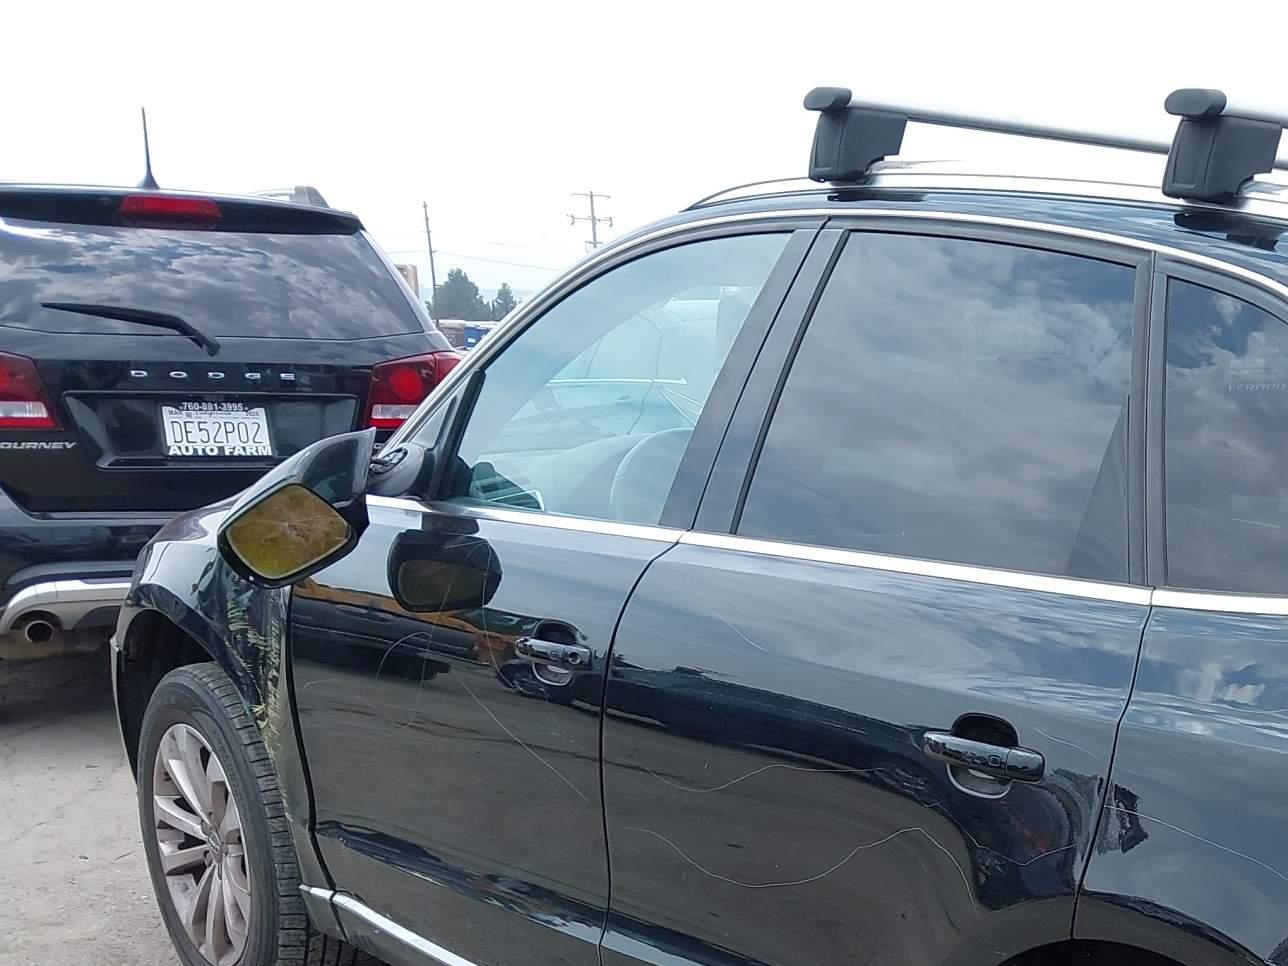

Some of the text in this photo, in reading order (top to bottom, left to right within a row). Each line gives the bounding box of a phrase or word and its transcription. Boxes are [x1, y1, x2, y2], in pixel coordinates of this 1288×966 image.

[129, 370, 296, 381] DODGE
[181, 401, 244, 412] 760-881-3995
[170, 420, 264, 444] DE52P02
[168, 445, 273, 456] AUTO FARM
